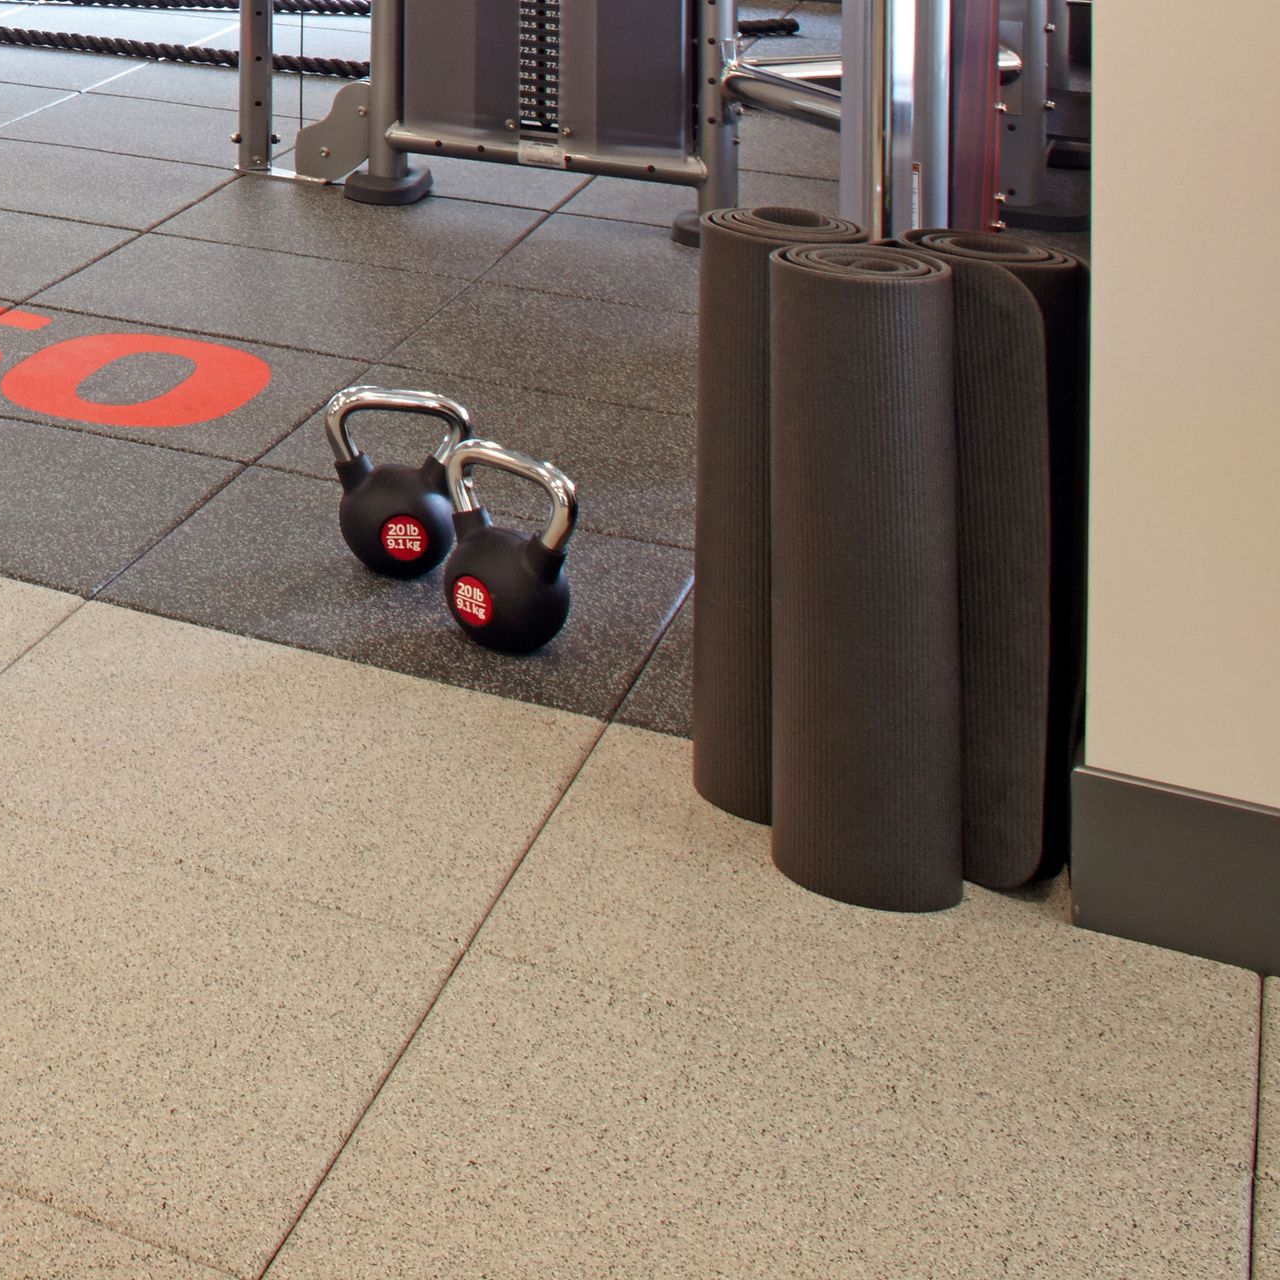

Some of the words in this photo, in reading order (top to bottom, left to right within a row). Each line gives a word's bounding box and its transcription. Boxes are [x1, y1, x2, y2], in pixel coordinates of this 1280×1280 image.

[387, 524, 405, 536] 20
[406, 524, 419, 536] lb
[386, 539, 405, 549] 9.1
[406, 539, 421, 552] kg
[457, 582, 472, 598] 20
[473, 588, 484, 602] lb
[456, 597, 471, 613] 9.1
[472, 603, 486, 620] kg
